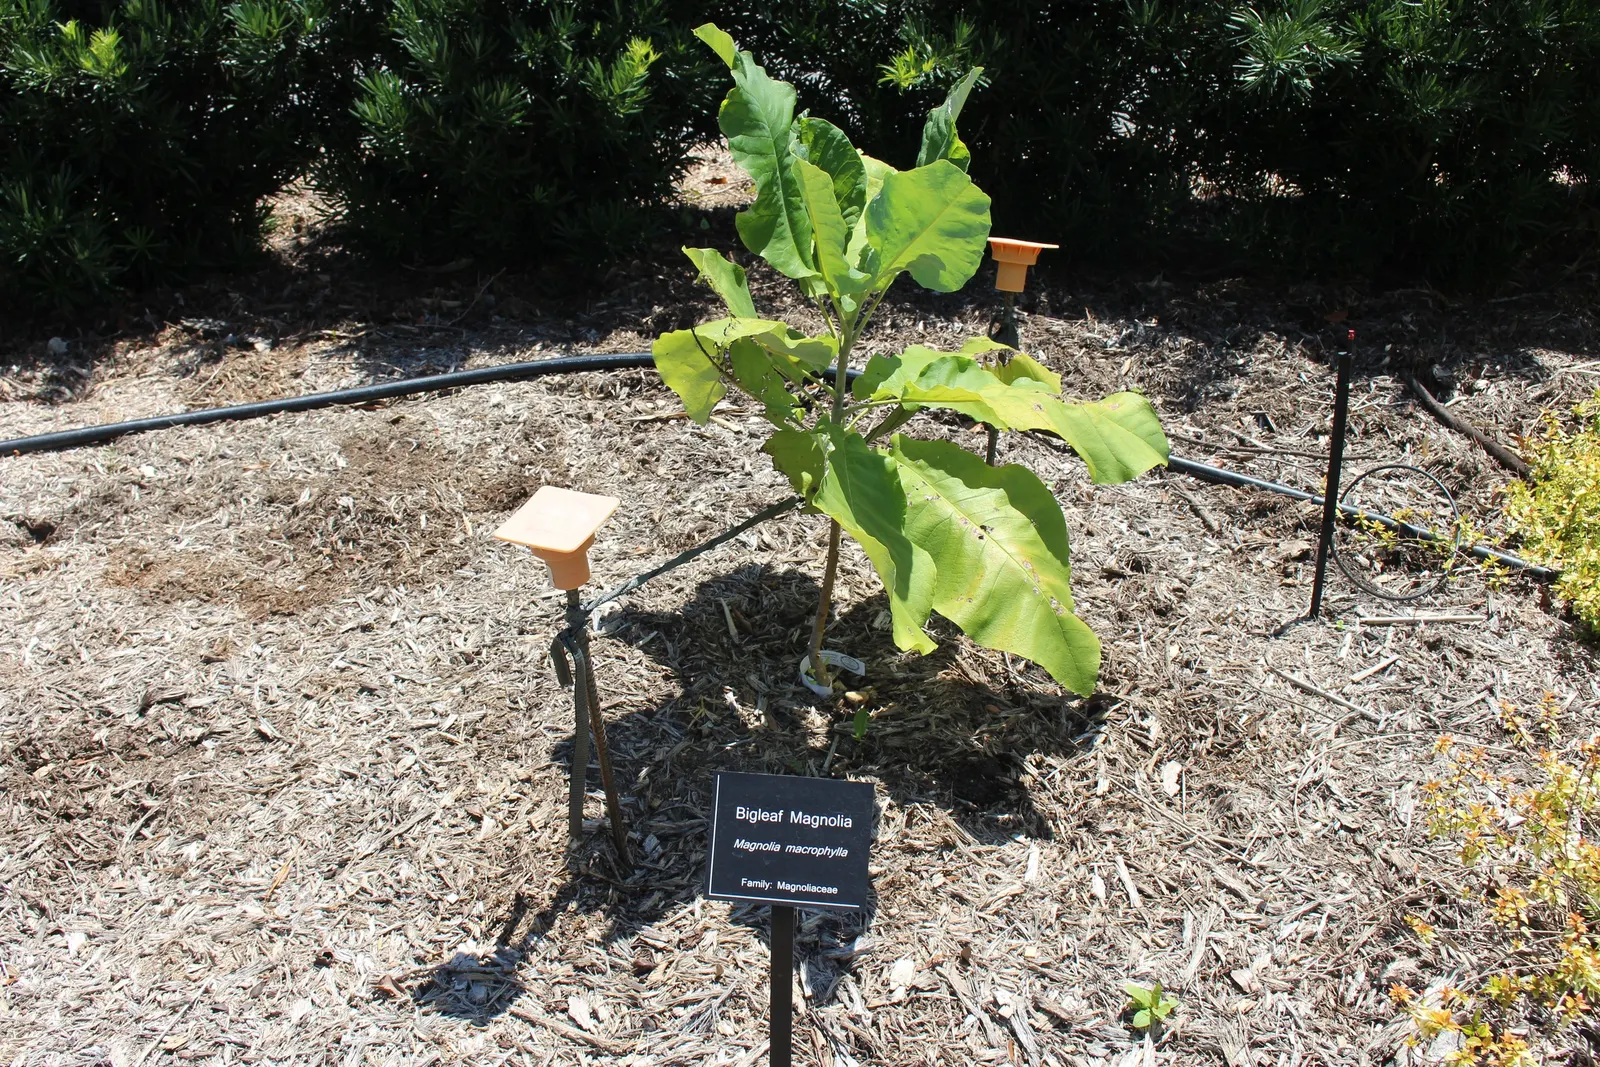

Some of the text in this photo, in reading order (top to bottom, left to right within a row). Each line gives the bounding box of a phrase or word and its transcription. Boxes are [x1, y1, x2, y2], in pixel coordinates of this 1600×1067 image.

[735, 806, 853, 829] Bigleaf Magnolia
[733, 838, 849, 859] Magnolia macrophylla
[741, 877, 839, 895] Family: Magnoliaceae
